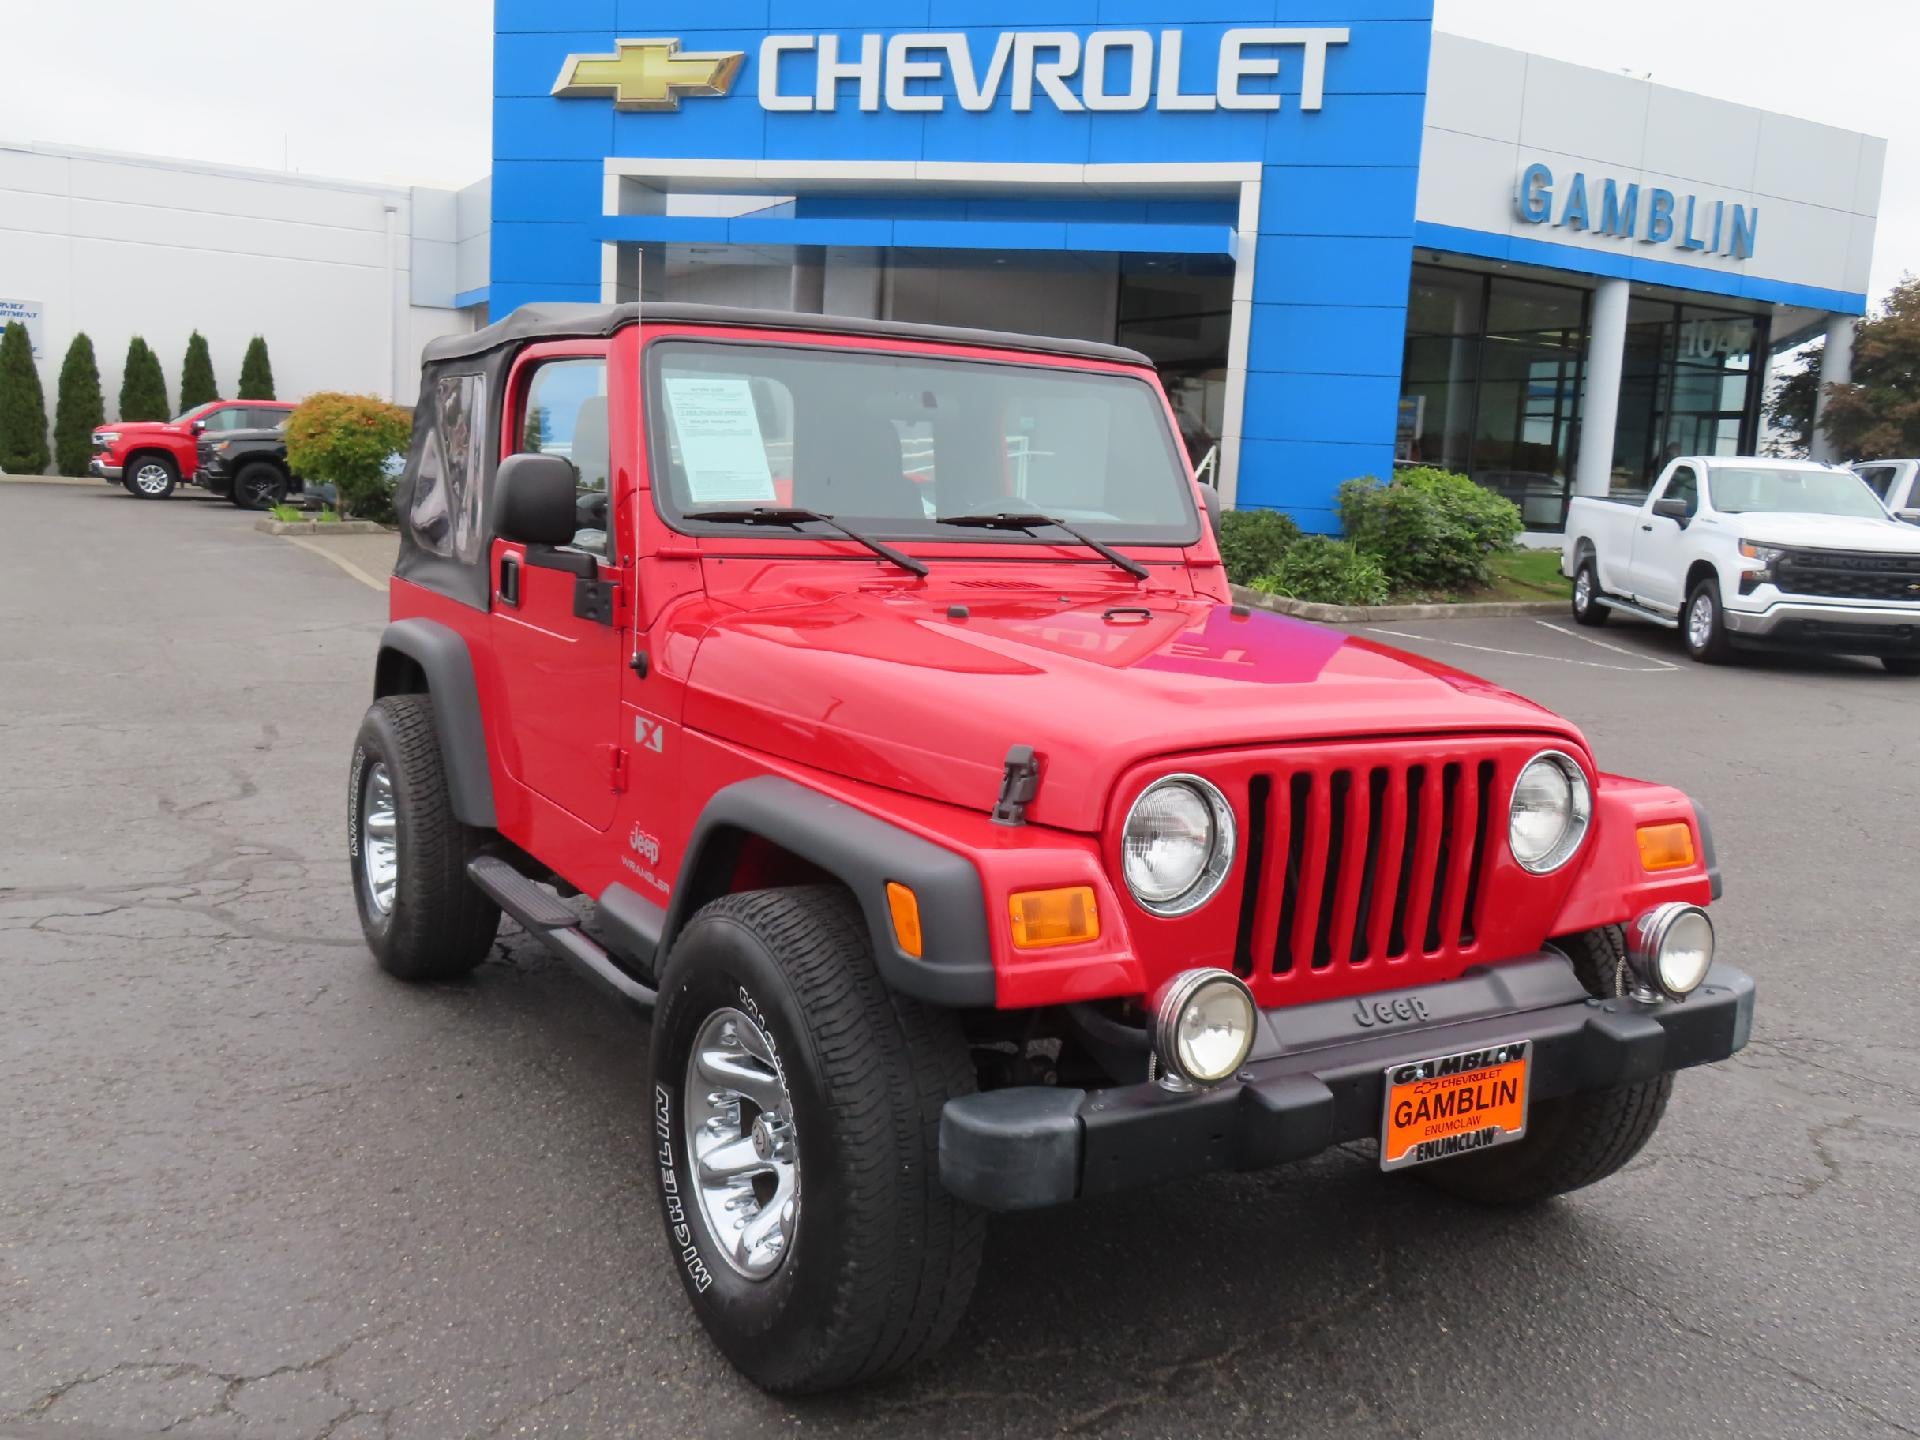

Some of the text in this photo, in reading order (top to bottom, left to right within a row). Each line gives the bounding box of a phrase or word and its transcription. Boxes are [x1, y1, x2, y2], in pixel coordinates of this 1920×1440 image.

[758, 27, 1350, 112] CHEVROLET
[1518, 163, 1758, 259] GAMBLIN
[637, 717, 662, 751] X
[629, 820, 660, 865] Jeep
[621, 855, 670, 895] WRANGLER
[1353, 997, 1429, 1027] Jeep
[1393, 1042, 1527, 1085] GAMBLIN
[1441, 1068, 1502, 1089] CHEVROLET
[1394, 1078, 1518, 1129] GAMBLIN
[1416, 1126, 1495, 1161] ENUMCLAW
[1424, 1115, 1482, 1136] ENUMCLAW
[655, 1084, 712, 1293] MICHELIN
